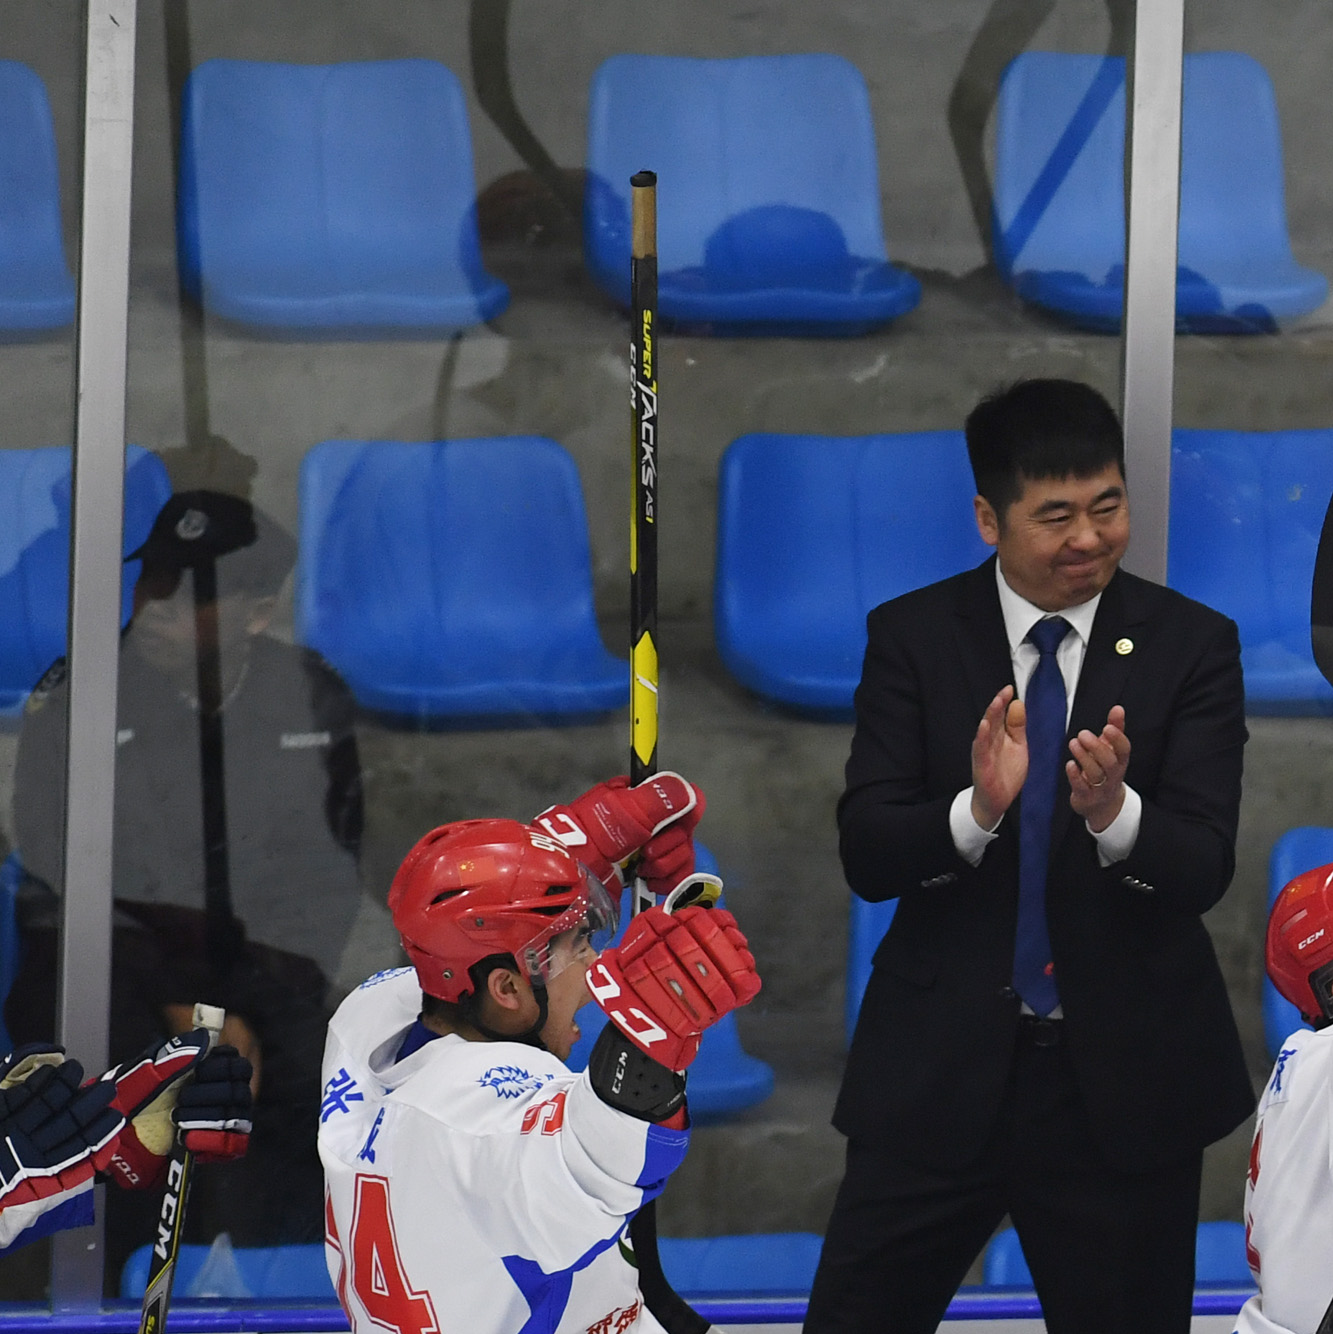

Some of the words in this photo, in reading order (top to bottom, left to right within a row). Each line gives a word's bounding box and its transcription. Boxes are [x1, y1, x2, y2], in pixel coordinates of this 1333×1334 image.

[642, 309, 652, 379] SUPER
[637, 379, 658, 489] TACKS
[1298, 928, 1325, 950] CCM
[611, 1051, 629, 1095] CCM
[154, 1157, 184, 1261] CCM
